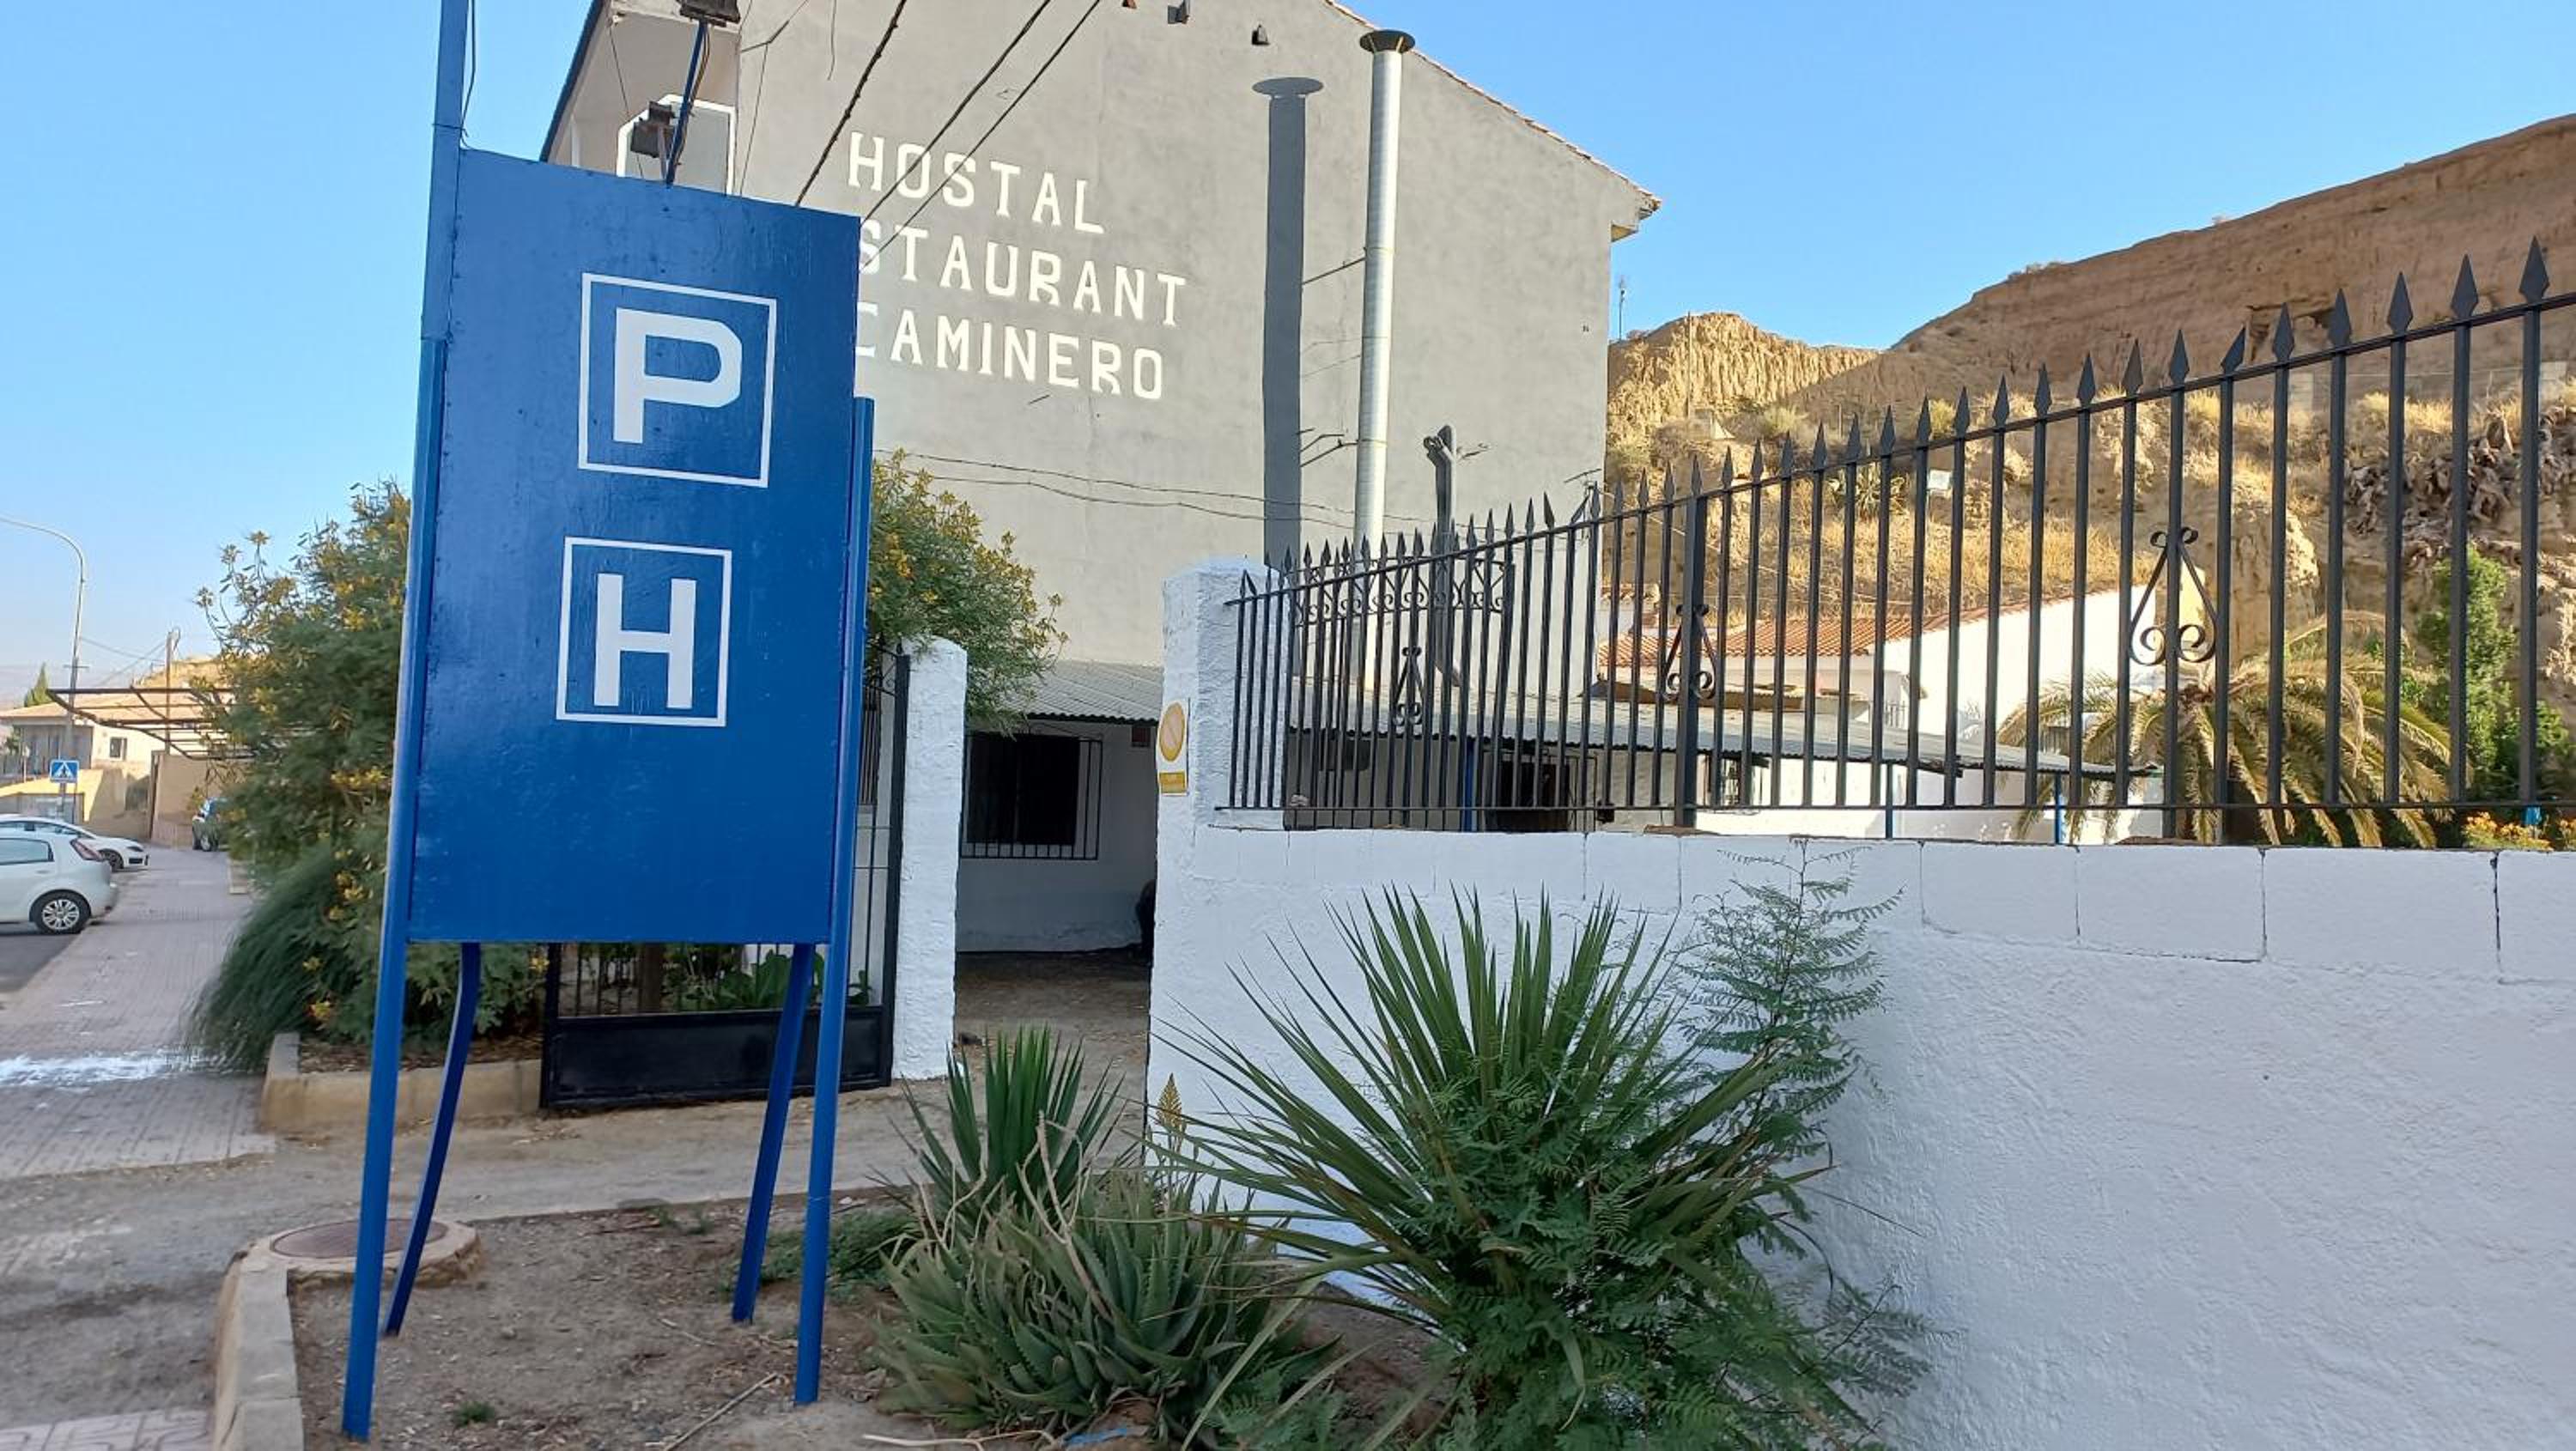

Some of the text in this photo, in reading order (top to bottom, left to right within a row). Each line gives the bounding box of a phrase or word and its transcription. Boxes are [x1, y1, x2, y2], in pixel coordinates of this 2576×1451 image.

[848, 131, 1104, 234] HOSTAL
[613, 307, 742, 443] P
[593, 573, 696, 709] H
